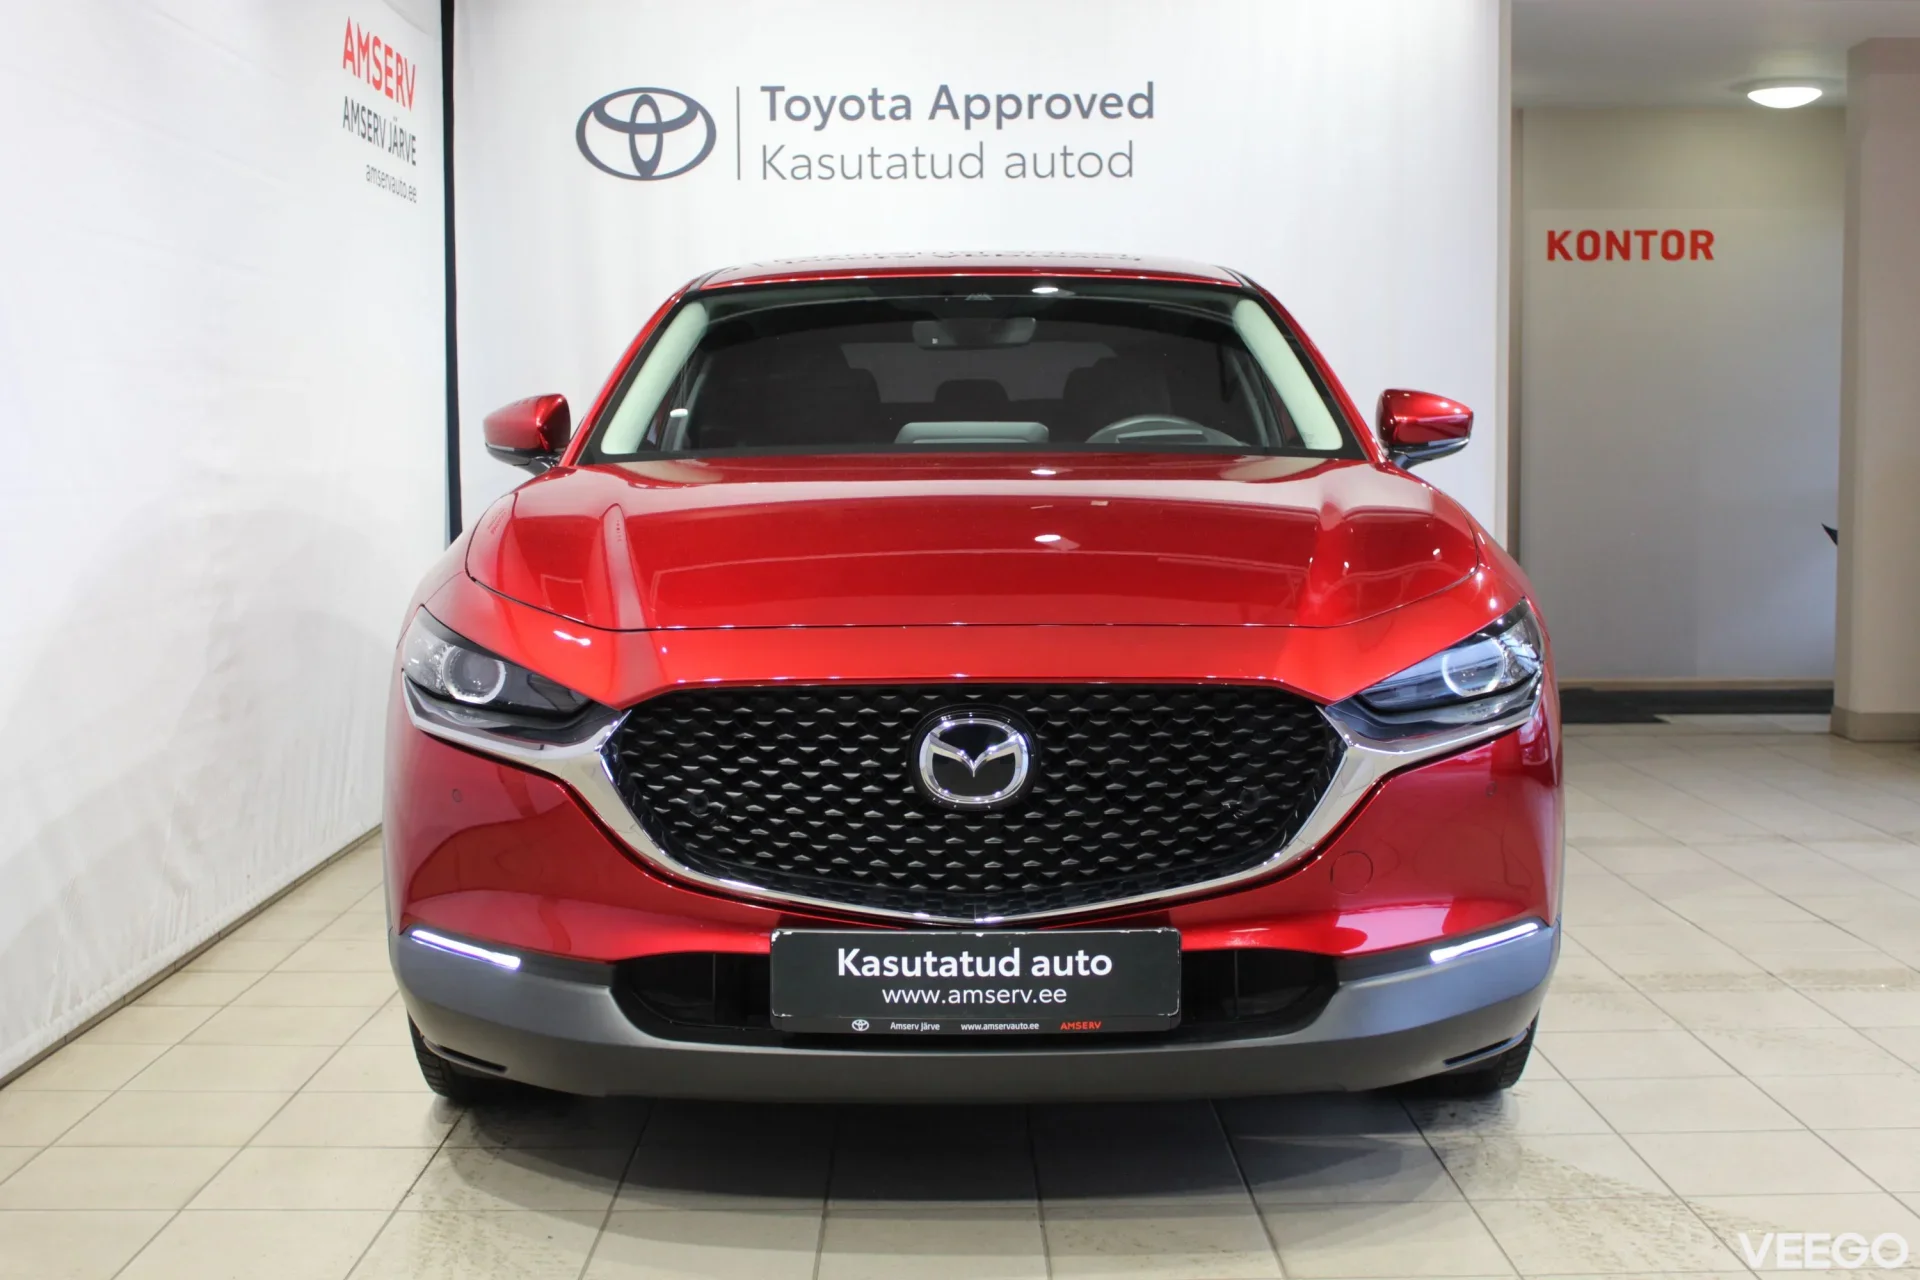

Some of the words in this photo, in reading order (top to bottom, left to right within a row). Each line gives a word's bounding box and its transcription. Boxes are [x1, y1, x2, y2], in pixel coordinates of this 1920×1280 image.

[342, 16, 416, 112] AMSERV
[760, 85, 912, 131] Toyota
[928, 81, 1155, 130] Approved
[342, 96, 387, 149] AMSERV
[387, 117, 416, 166] JÄRVE
[761, 141, 985, 181] Kasutatud
[1004, 140, 1134, 179] autod
[365, 163, 417, 204] amservauto.ee
[1547, 229, 1715, 261] KONTOR
[837, 947, 1021, 977] Kasutatud
[1031, 950, 1113, 977] auto
[882, 986, 1067, 1004] www.amserv.ee
[890, 1021, 919, 1031] Amserv
[921, 1021, 940, 1032] Järve
[961, 1021, 1040, 1031] www.amservauto.ee
[1060, 1021, 1102, 1030] AMSERV
